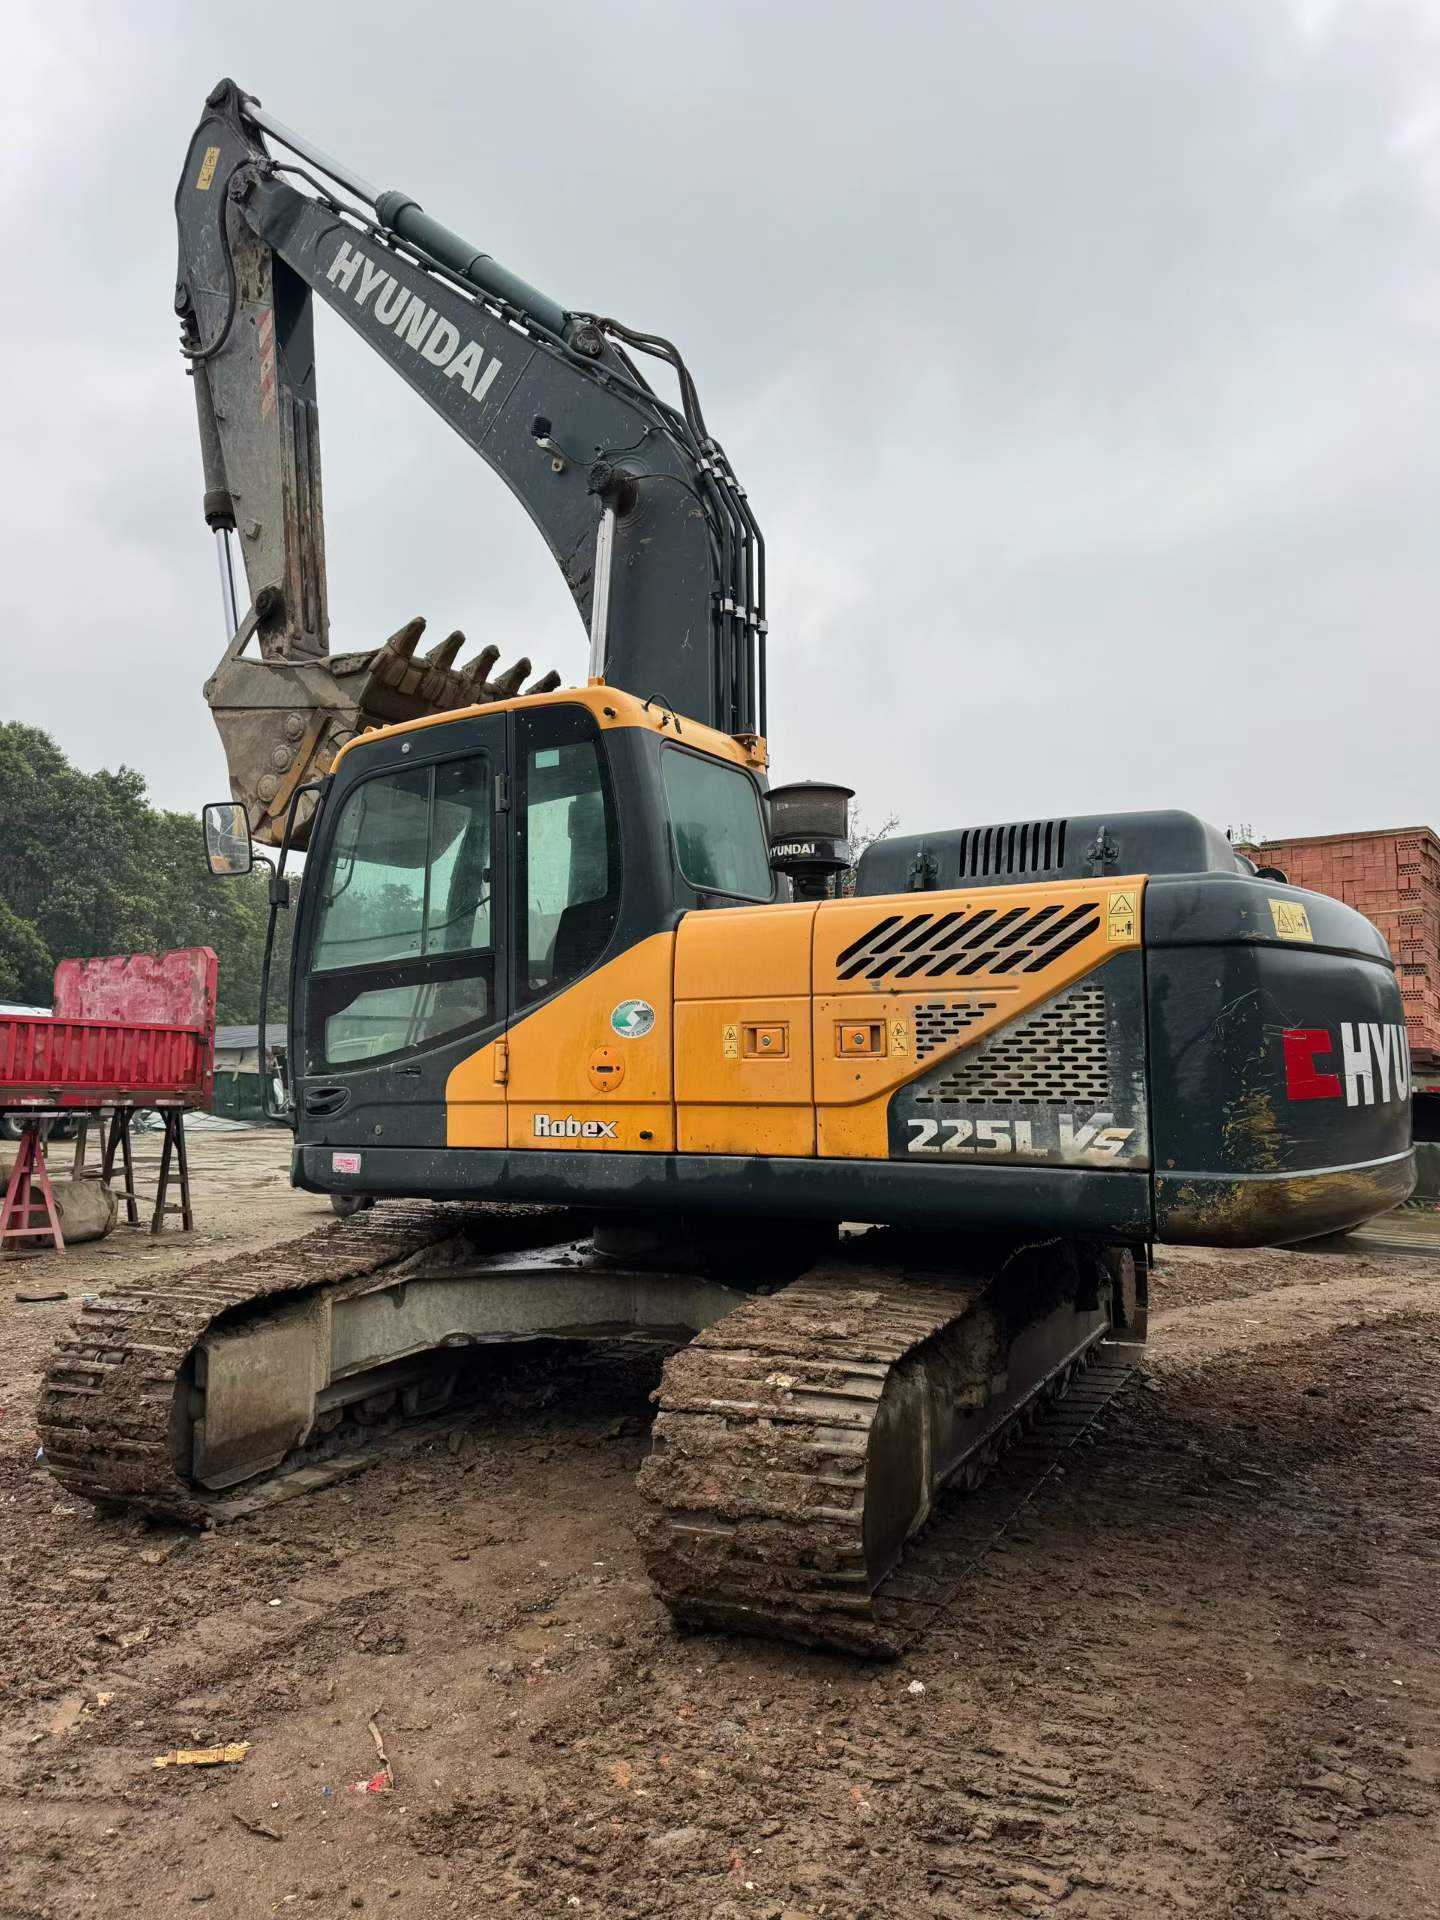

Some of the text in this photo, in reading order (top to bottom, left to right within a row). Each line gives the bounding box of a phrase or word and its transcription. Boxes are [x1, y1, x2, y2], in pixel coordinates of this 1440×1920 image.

[326, 240, 503, 403] HYUNDAI
[1340, 1022, 1412, 1107] HYU
[534, 1114, 618, 1138] Robex
[907, 1118, 1048, 1156] 225L
